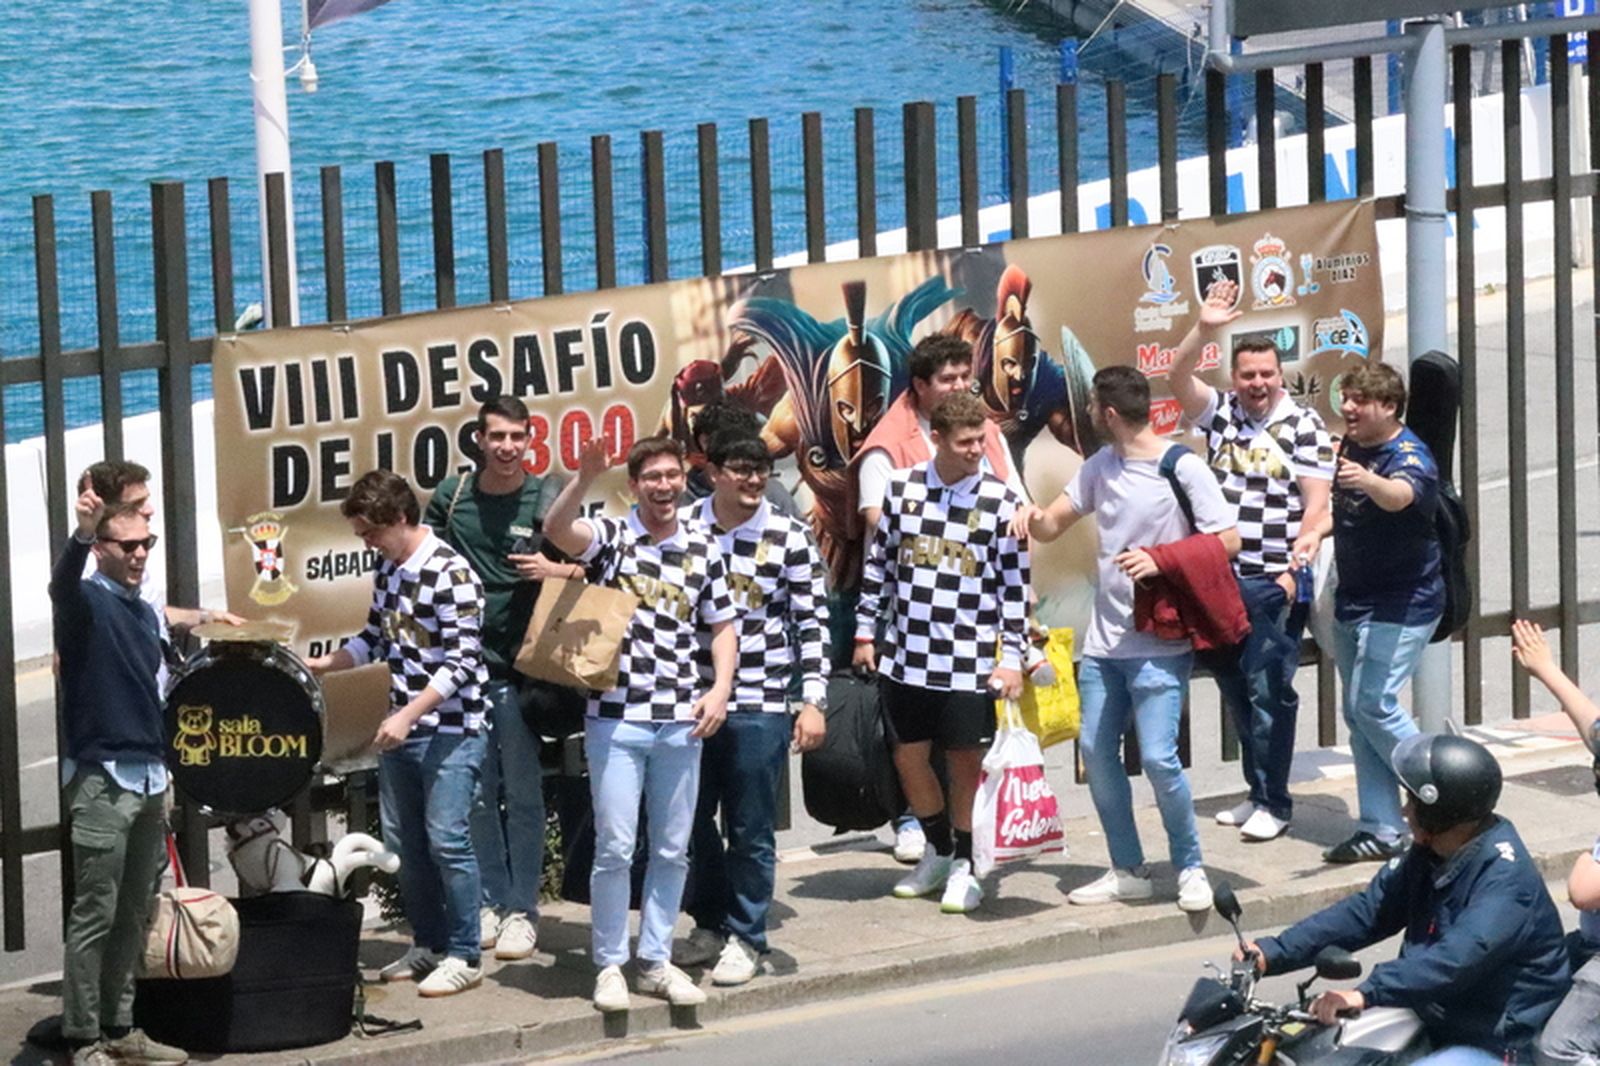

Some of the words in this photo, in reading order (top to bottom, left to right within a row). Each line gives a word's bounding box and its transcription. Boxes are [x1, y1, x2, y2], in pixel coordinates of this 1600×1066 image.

[240, 356, 359, 430] VIII
[382, 312, 656, 414] DESAFÍO
[272, 438, 350, 507] DE
[377, 420, 485, 492] LOS
[521, 404, 635, 475] 300
[898, 535, 977, 577] CEUTA
[218, 714, 262, 734] sala
[218, 733, 308, 758] BLOOM
